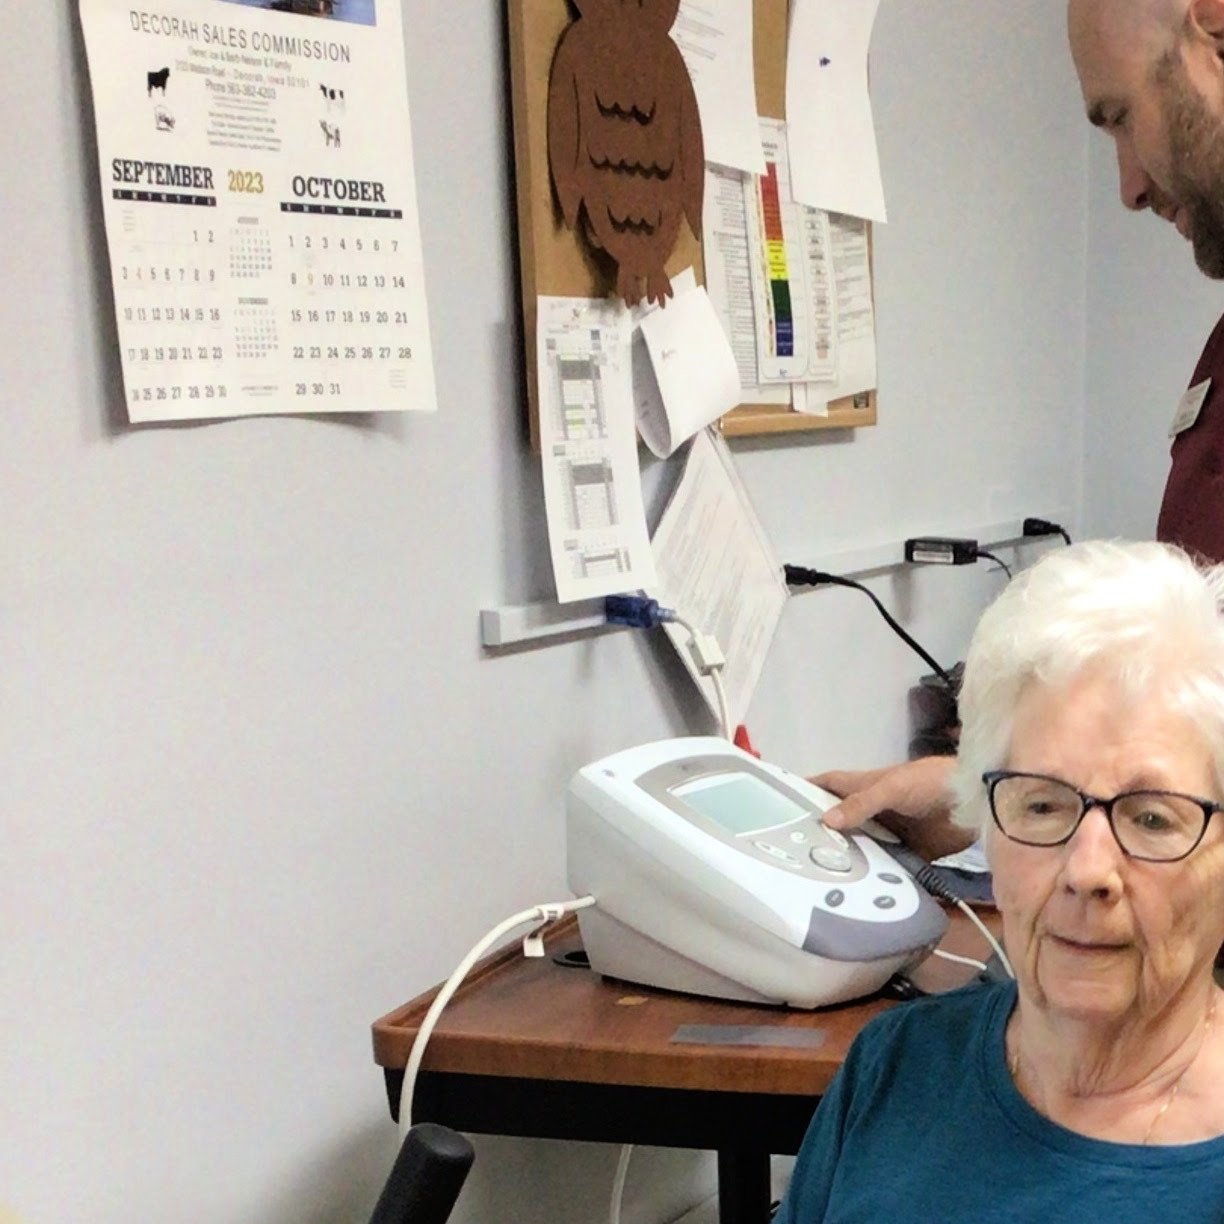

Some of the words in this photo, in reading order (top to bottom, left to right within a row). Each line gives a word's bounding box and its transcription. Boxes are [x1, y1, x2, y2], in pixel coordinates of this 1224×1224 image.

[130, 10, 199, 41] DECORAH
[202, 23, 248, 49] SALES
[252, 31, 351, 63] COMMISSION
[112, 158, 214, 190] SEPTEMBER
[227, 169, 264, 194] 2023
[292, 175, 386, 203] OCTOBER
[193, 230, 198, 242] 1
[208, 230, 214, 243] 2
[289, 236, 294, 247] 1
[305, 236, 311, 248] 2
[322, 237, 328, 249] 3
[340, 238, 346, 250] 4
[356, 239, 363, 250] 5
[374, 240, 380, 251] 6
[392, 240, 398, 252] 7
[151, 267, 156, 280] 5
[180, 268, 184, 280] 7
[291, 273, 296, 284] 8
[323, 274, 334, 286] 10
[340, 274, 350, 286] 11
[357, 275, 368, 287] 12
[374, 276, 386, 288] 13
[392, 276, 405, 288] 14
[166, 308, 174, 321] 13
[180, 308, 190, 321] 14
[210, 308, 220, 321] 16
[291, 310, 302, 322] 15
[308, 310, 319, 322] 16
[325, 310, 336, 322] 17
[342, 311, 353, 322] 18
[359, 311, 370, 323] 19
[376, 311, 388, 323] 20
[395, 312, 408, 324] 21
[182, 347, 192, 360] 21
[293, 347, 304, 359] 22
[310, 347, 321, 359] 23
[327, 347, 339, 359] 24
[344, 347, 356, 359] 25
[361, 347, 373, 359] 26
[379, 347, 390, 359] 27
[398, 347, 412, 359] 28
[156, 387, 166, 400] 26
[172, 386, 182, 400] 27
[296, 384, 306, 395] 29
[312, 384, 324, 395] 30
[330, 384, 340, 395] 31
